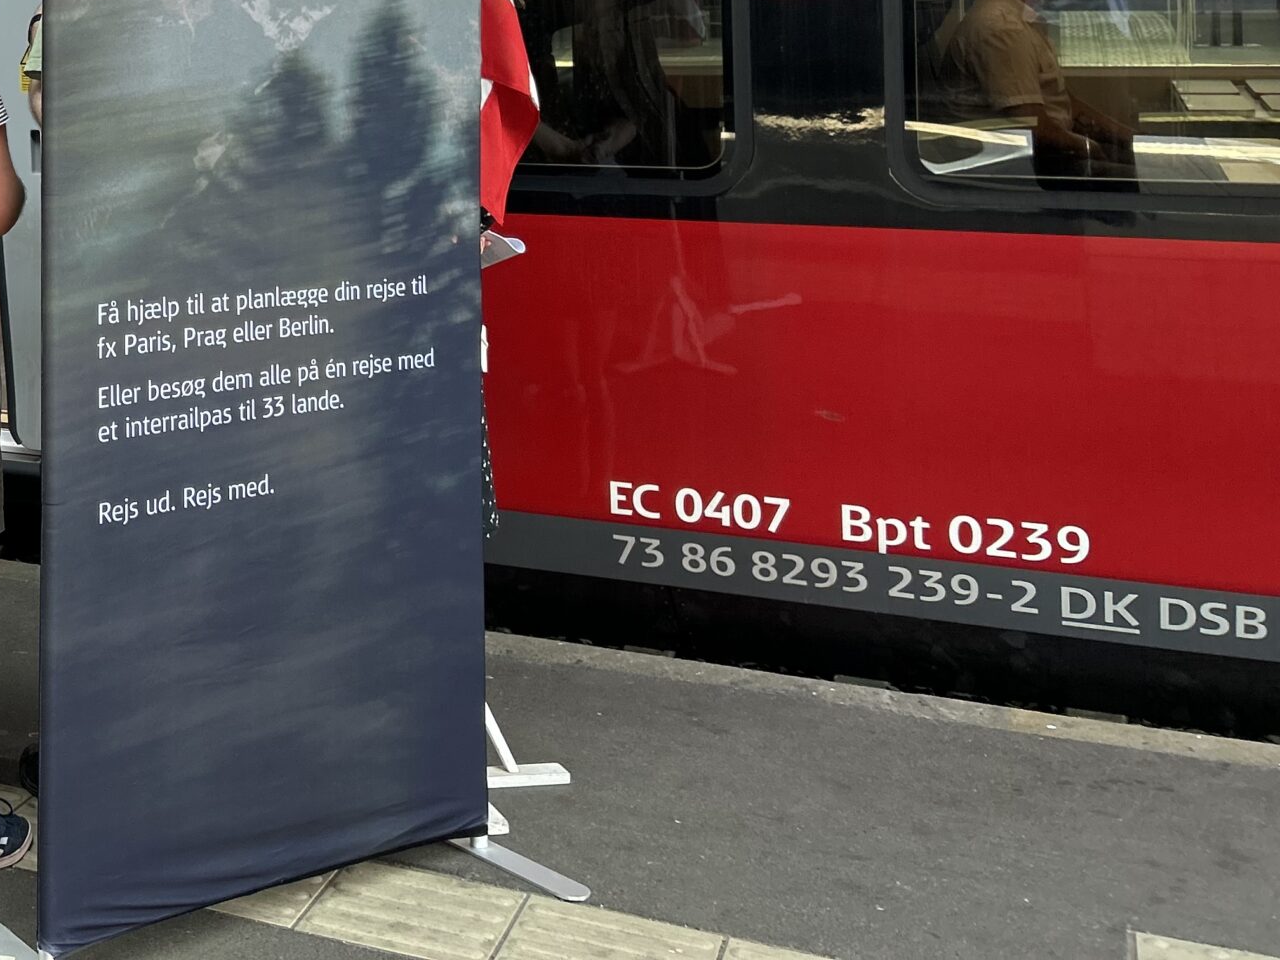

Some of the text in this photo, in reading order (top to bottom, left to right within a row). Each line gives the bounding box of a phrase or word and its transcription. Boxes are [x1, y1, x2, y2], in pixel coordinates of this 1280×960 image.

[97, 274, 428, 326] Få hjælp til at planlægge din rejse til
[96, 313, 334, 360] fx Paris, Prag eller Berlin.
[98, 347, 435, 409] Eller besøg dem alle på én rejse med
[98, 389, 345, 443] et interrailpas til 33 lande.
[99, 473, 275, 525] Rejs ud. Rejs med.
[609, 480, 1090, 564] EC 0407 Bpt 0239
[612, 534, 1268, 640] 73 86 8293 239-2 DK DSB
